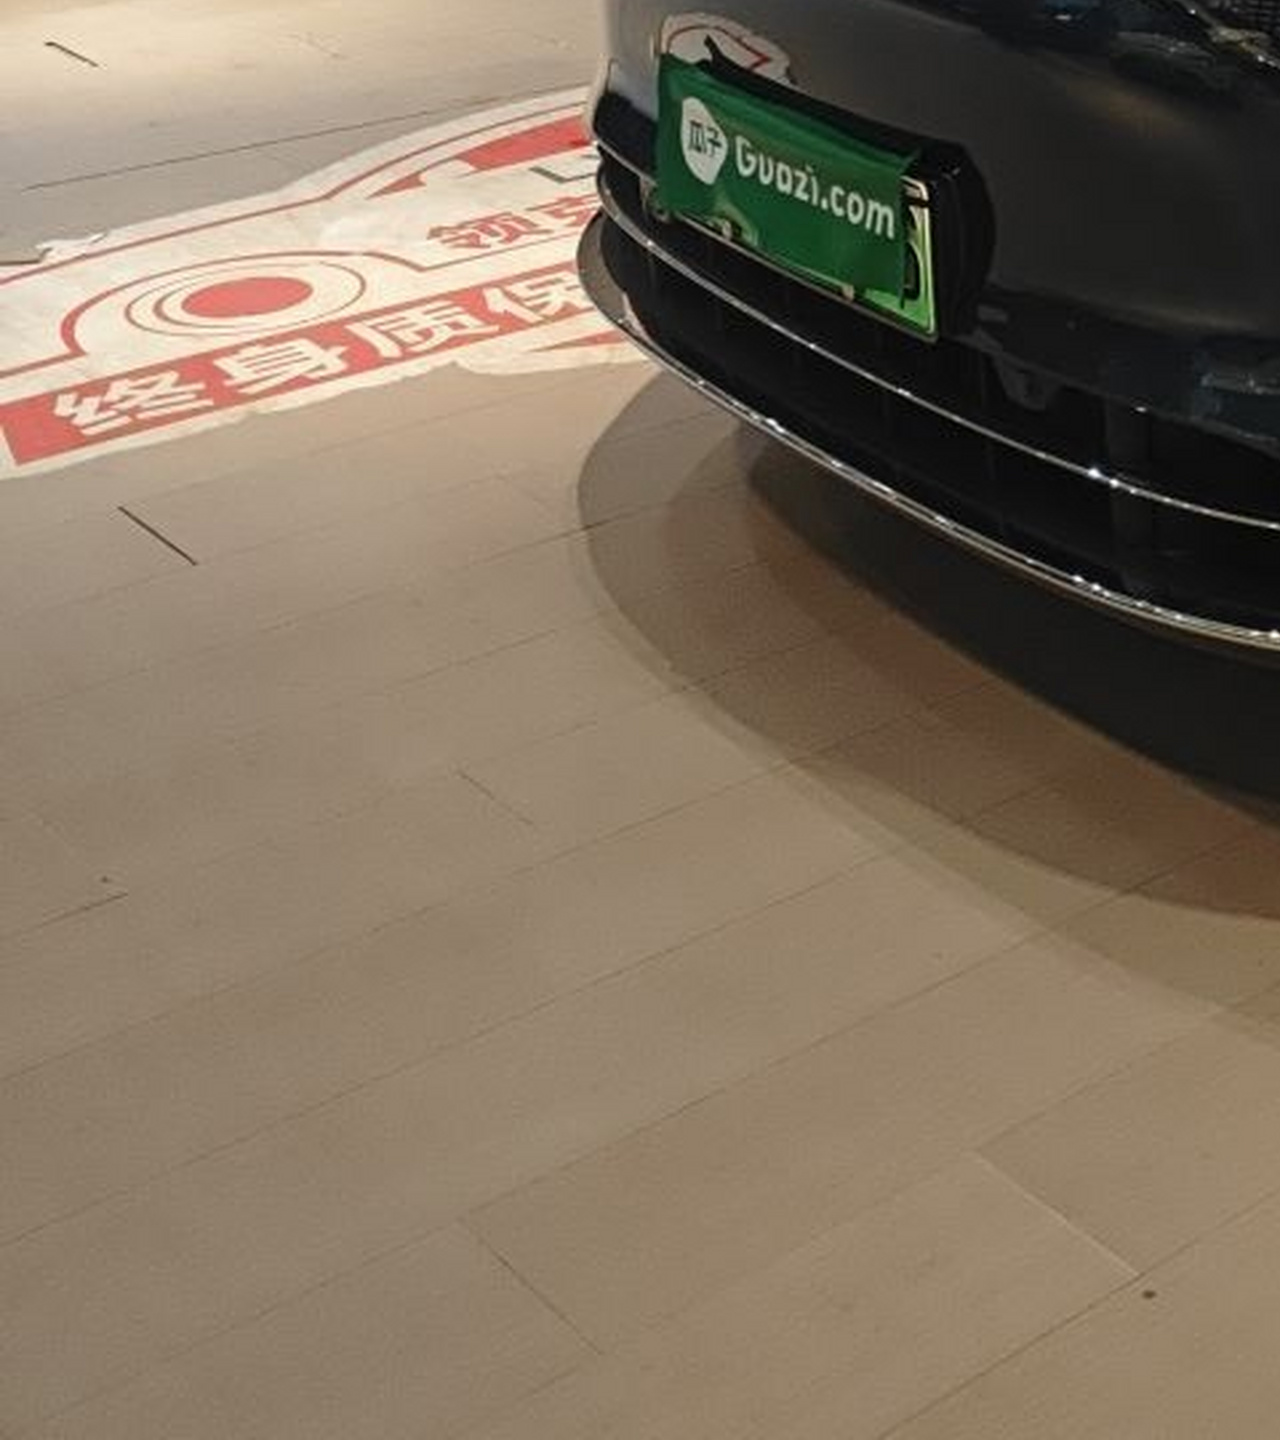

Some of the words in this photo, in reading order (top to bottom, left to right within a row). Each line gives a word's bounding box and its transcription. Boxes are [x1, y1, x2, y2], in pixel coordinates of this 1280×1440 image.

[688, 120, 723, 157] 瓜子
[735, 135, 896, 240] Guazi.com
[52, 269, 596, 436] 终身质保
